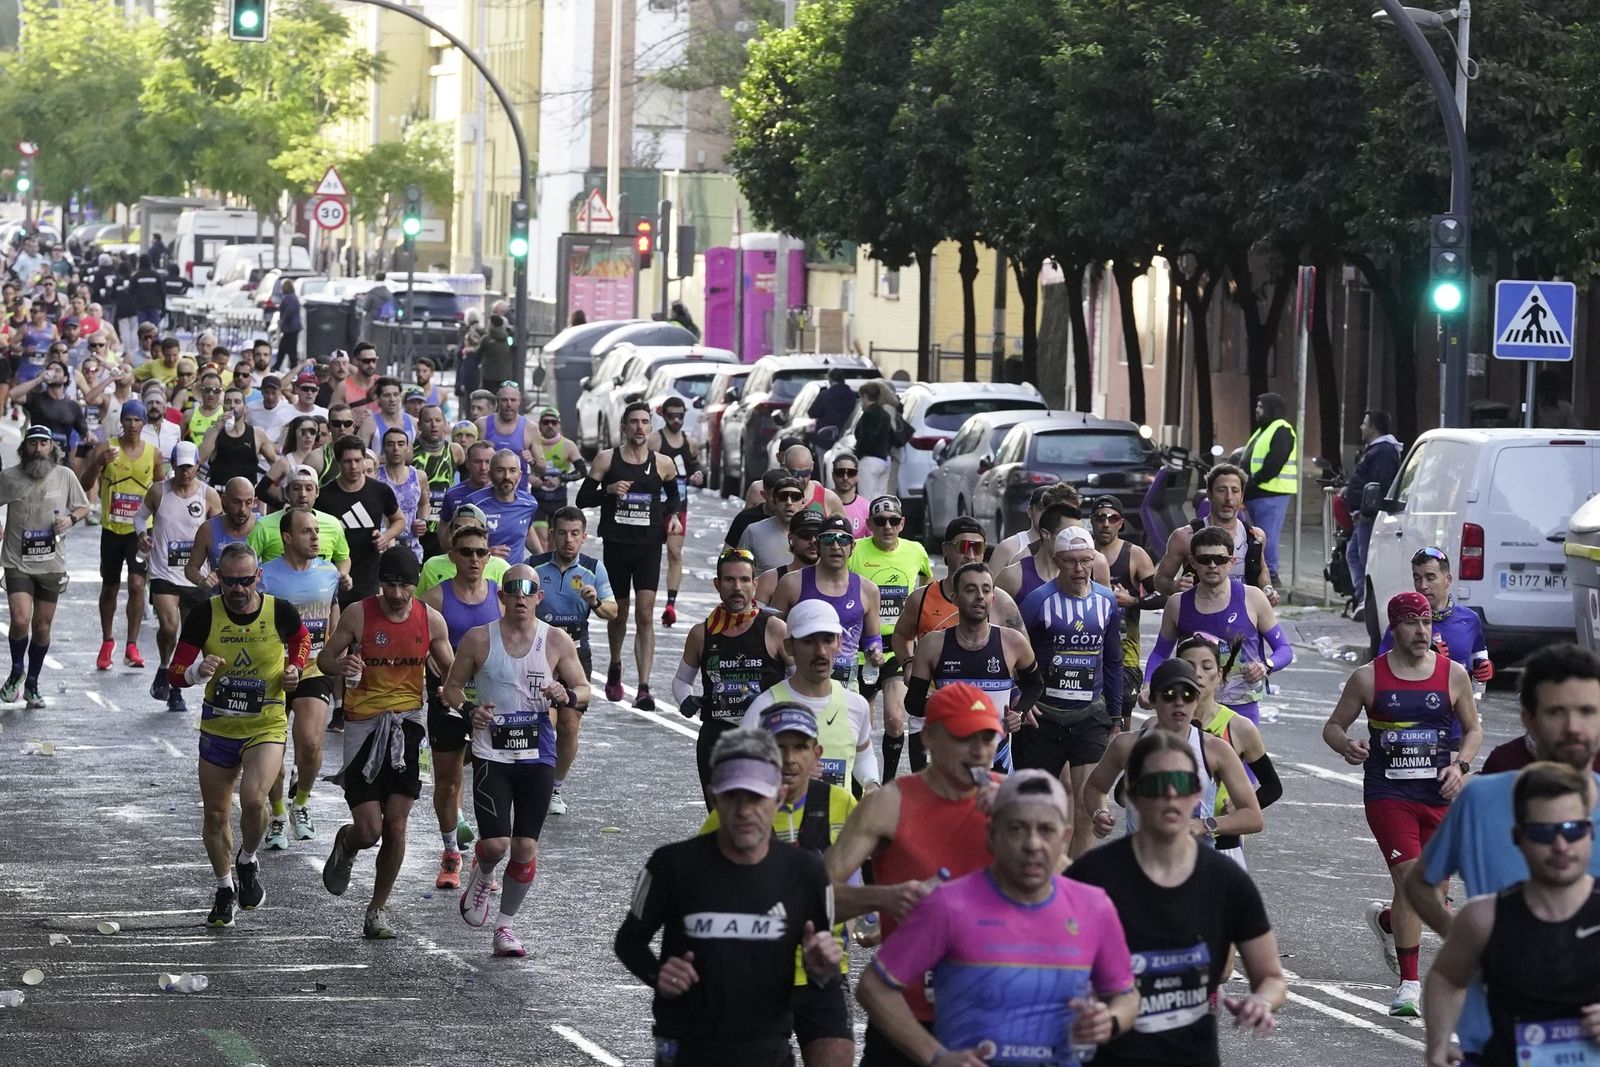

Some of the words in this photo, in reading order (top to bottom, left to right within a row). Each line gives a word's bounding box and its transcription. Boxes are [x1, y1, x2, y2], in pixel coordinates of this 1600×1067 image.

[321, 208, 341, 219] 30
[629, 510, 650, 519] GOMEZ
[853, 517, 859, 529] 8
[28, 546, 51, 555] SERGIO
[1508, 574, 1540, 588] 9177
[1544, 575, 1569, 588] MFY
[220, 636, 244, 644] GPDM
[1064, 657, 1091, 665] ZURICH
[1064, 670, 1079, 678] 4997
[232, 679, 262, 688] ZURICH
[1059, 679, 1083, 690] PAUL
[226, 700, 249, 711] TANI
[711, 710, 732, 718] LUCAS
[508, 715, 535, 723] ZURICH
[508, 729, 524, 737] 4954
[1401, 732, 1431, 740] ZURICH
[504, 738, 529, 749] JOHN
[1401, 747, 1419, 755] 5216
[1390, 756, 1432, 768] JUANMA
[1151, 951, 1202, 968] ZURICH
[1001, 1045, 1053, 1058] ZURICH
